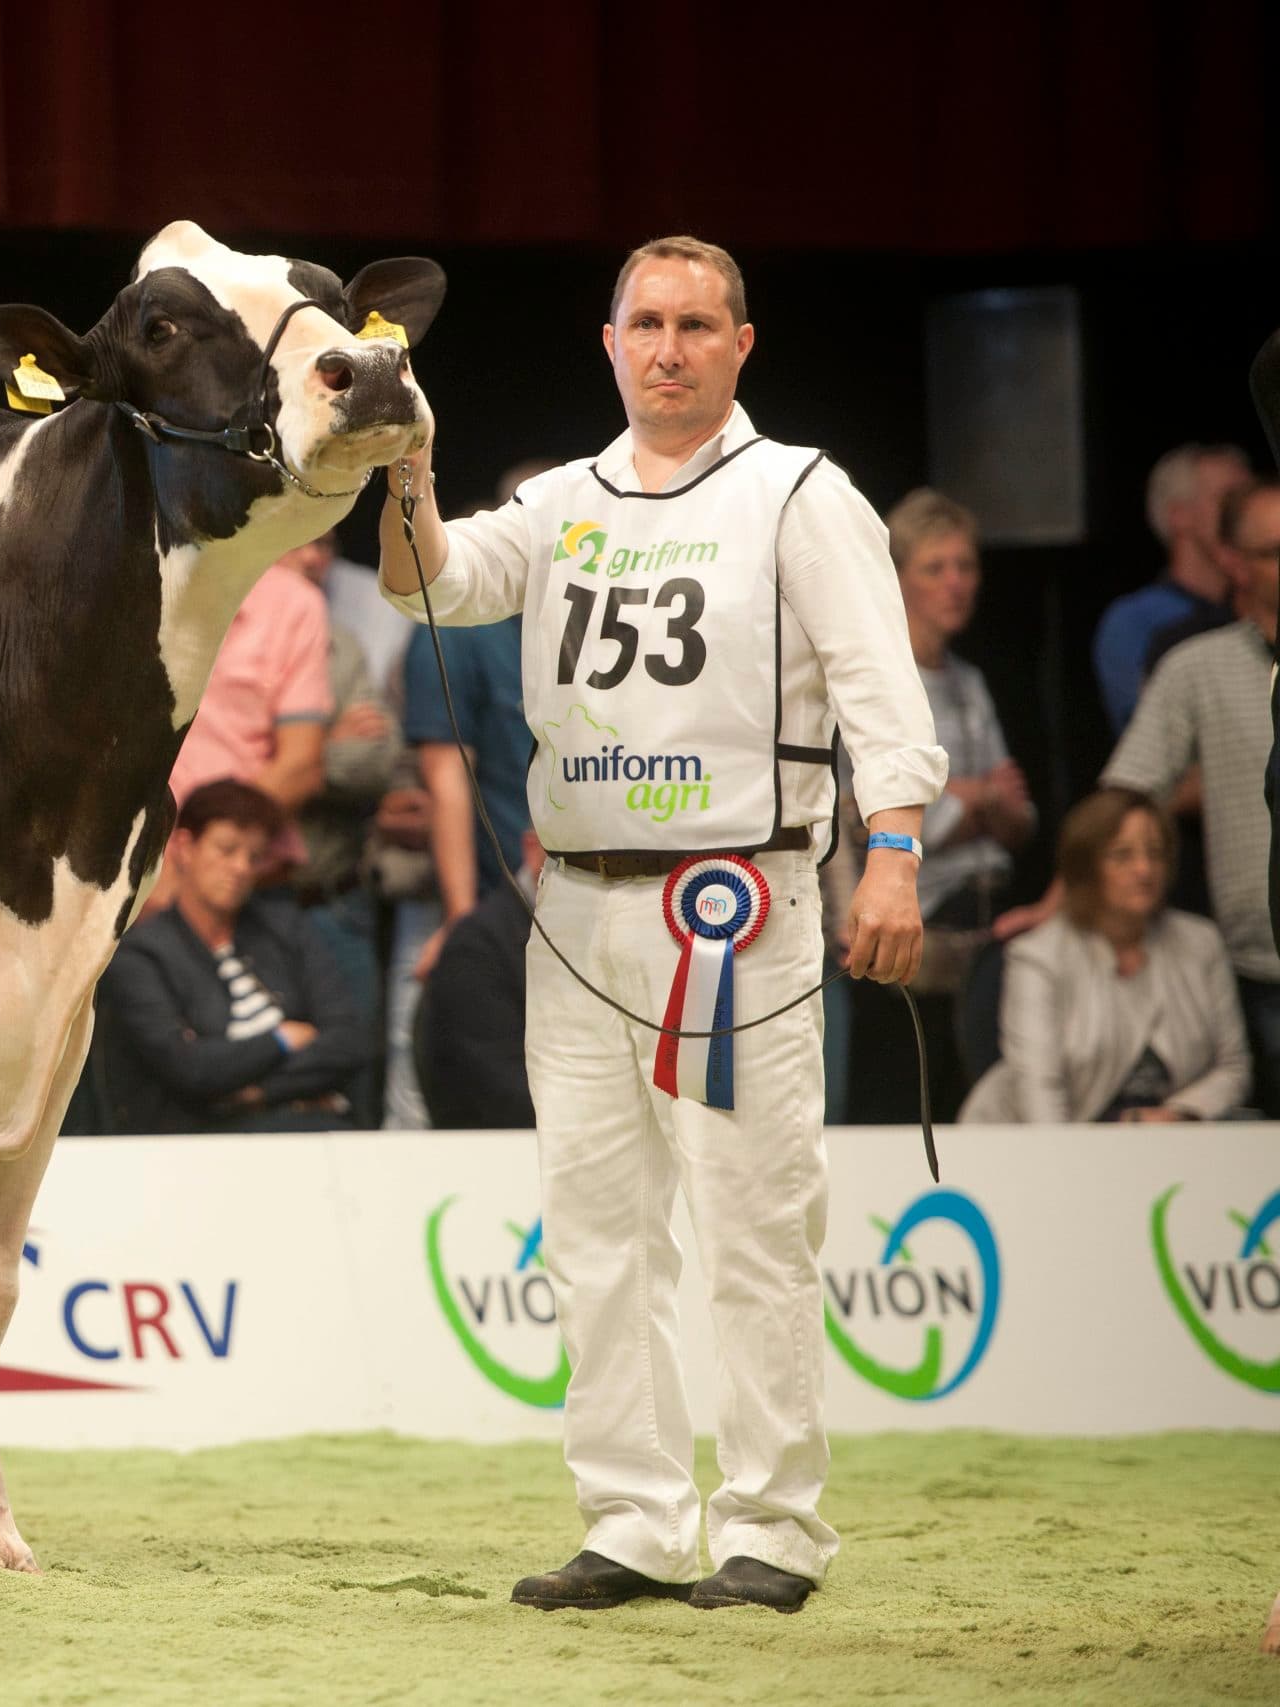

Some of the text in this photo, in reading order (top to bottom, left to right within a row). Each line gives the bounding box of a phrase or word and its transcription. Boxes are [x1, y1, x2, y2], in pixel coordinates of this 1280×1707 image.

[557, 577, 707, 690] 153
[562, 745, 702, 783] uniform
[626, 773, 712, 823] agri
[458, 1275, 557, 1325] VIO
[825, 1268, 975, 1319] VION
[1184, 1262, 1280, 1312] VIO
[62, 1280, 237, 1361] CRV
